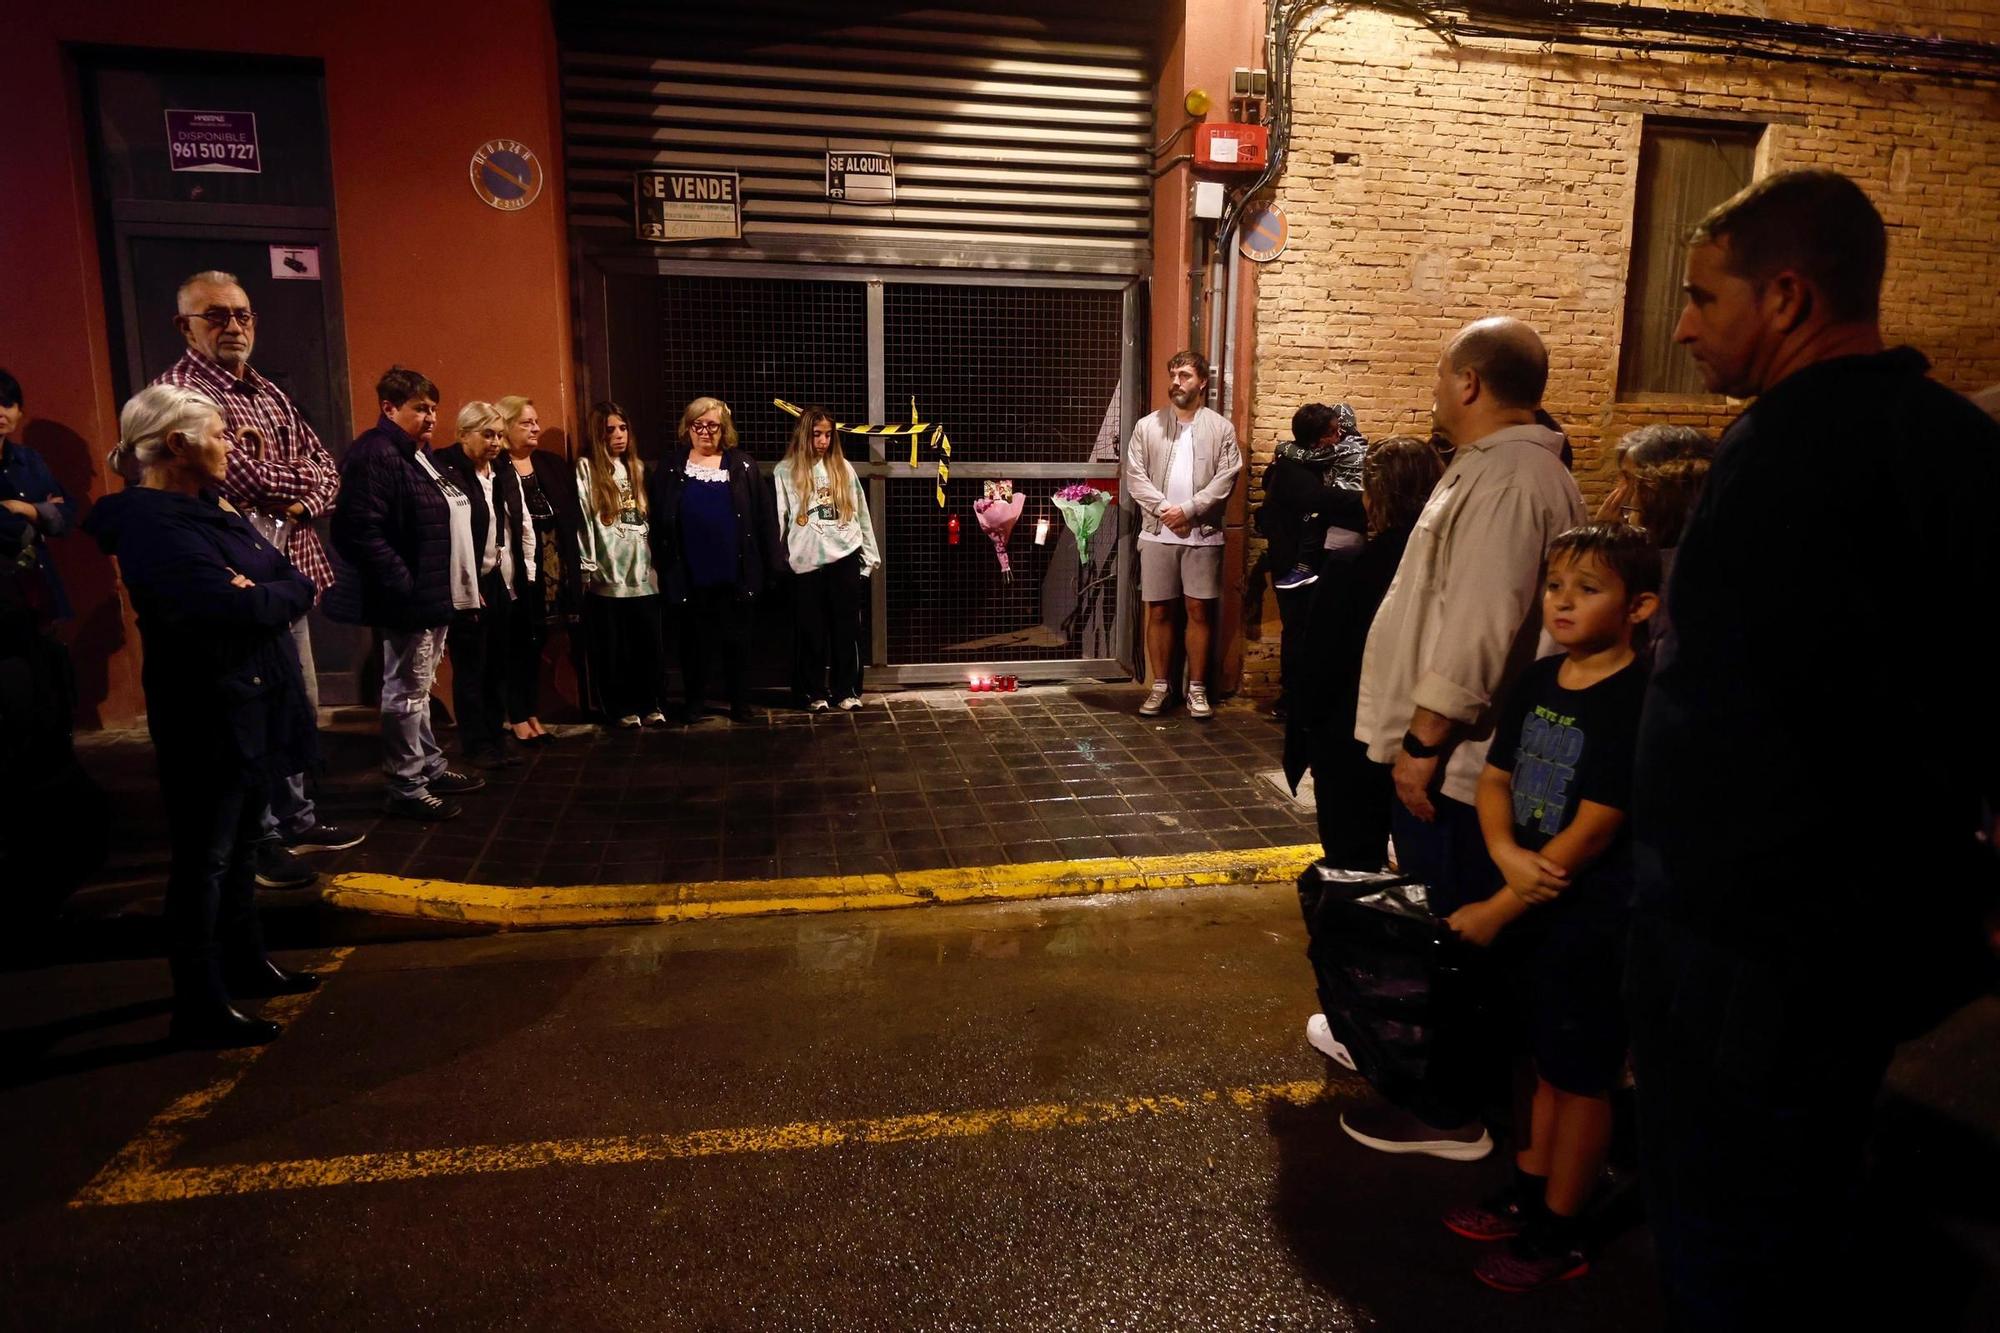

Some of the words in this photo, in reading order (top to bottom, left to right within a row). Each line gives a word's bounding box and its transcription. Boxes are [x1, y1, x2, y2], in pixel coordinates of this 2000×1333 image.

[178, 130, 247, 142] DISPONIBLE
[172, 142, 198, 158] 961
[199, 143, 225, 159] 510
[227, 144, 254, 160] 727
[830, 157, 844, 171] SE
[846, 157, 892, 174] ALQUILA
[642, 176, 665, 198] SE
[670, 176, 733, 200] VENDE
